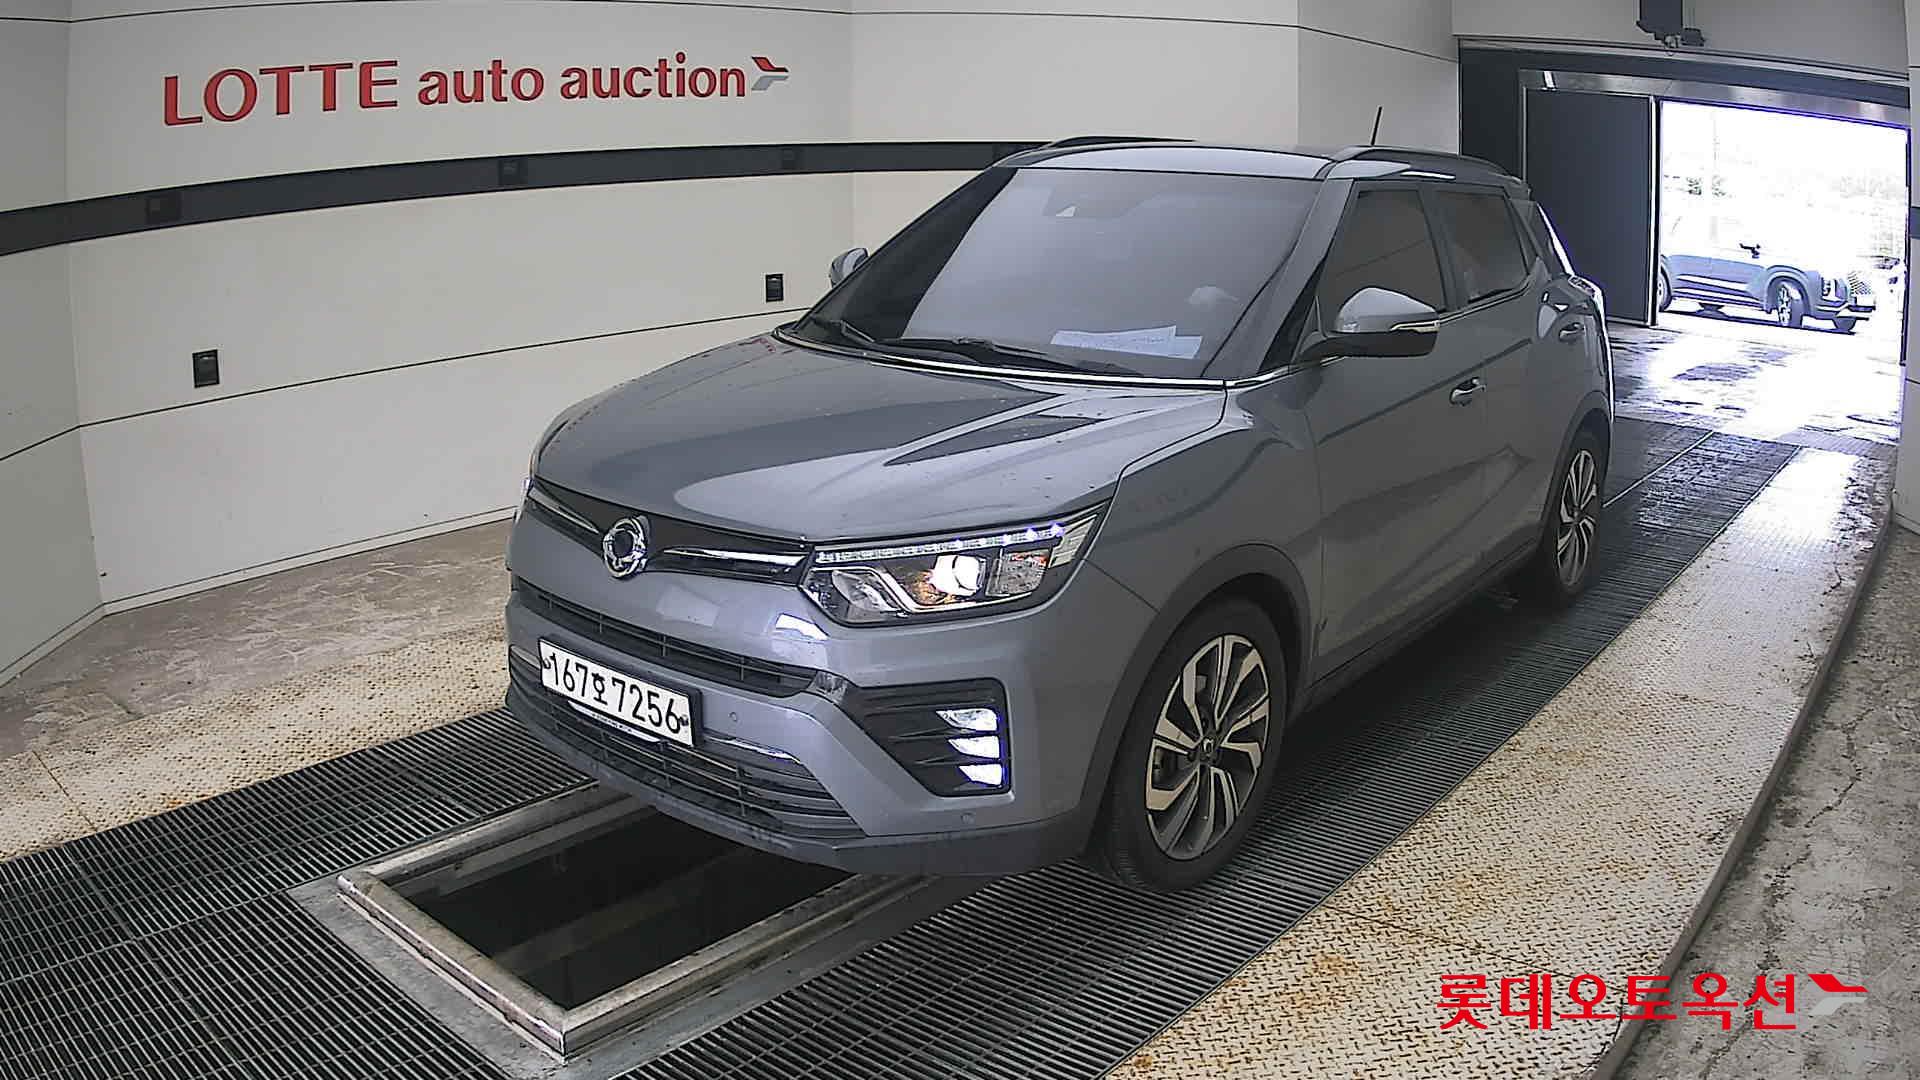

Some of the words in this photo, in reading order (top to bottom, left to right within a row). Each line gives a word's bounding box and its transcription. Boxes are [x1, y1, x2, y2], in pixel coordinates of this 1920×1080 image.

[164, 60, 398, 126] LOTTE
[417, 59, 544, 104] auto
[560, 51, 746, 98] auction
